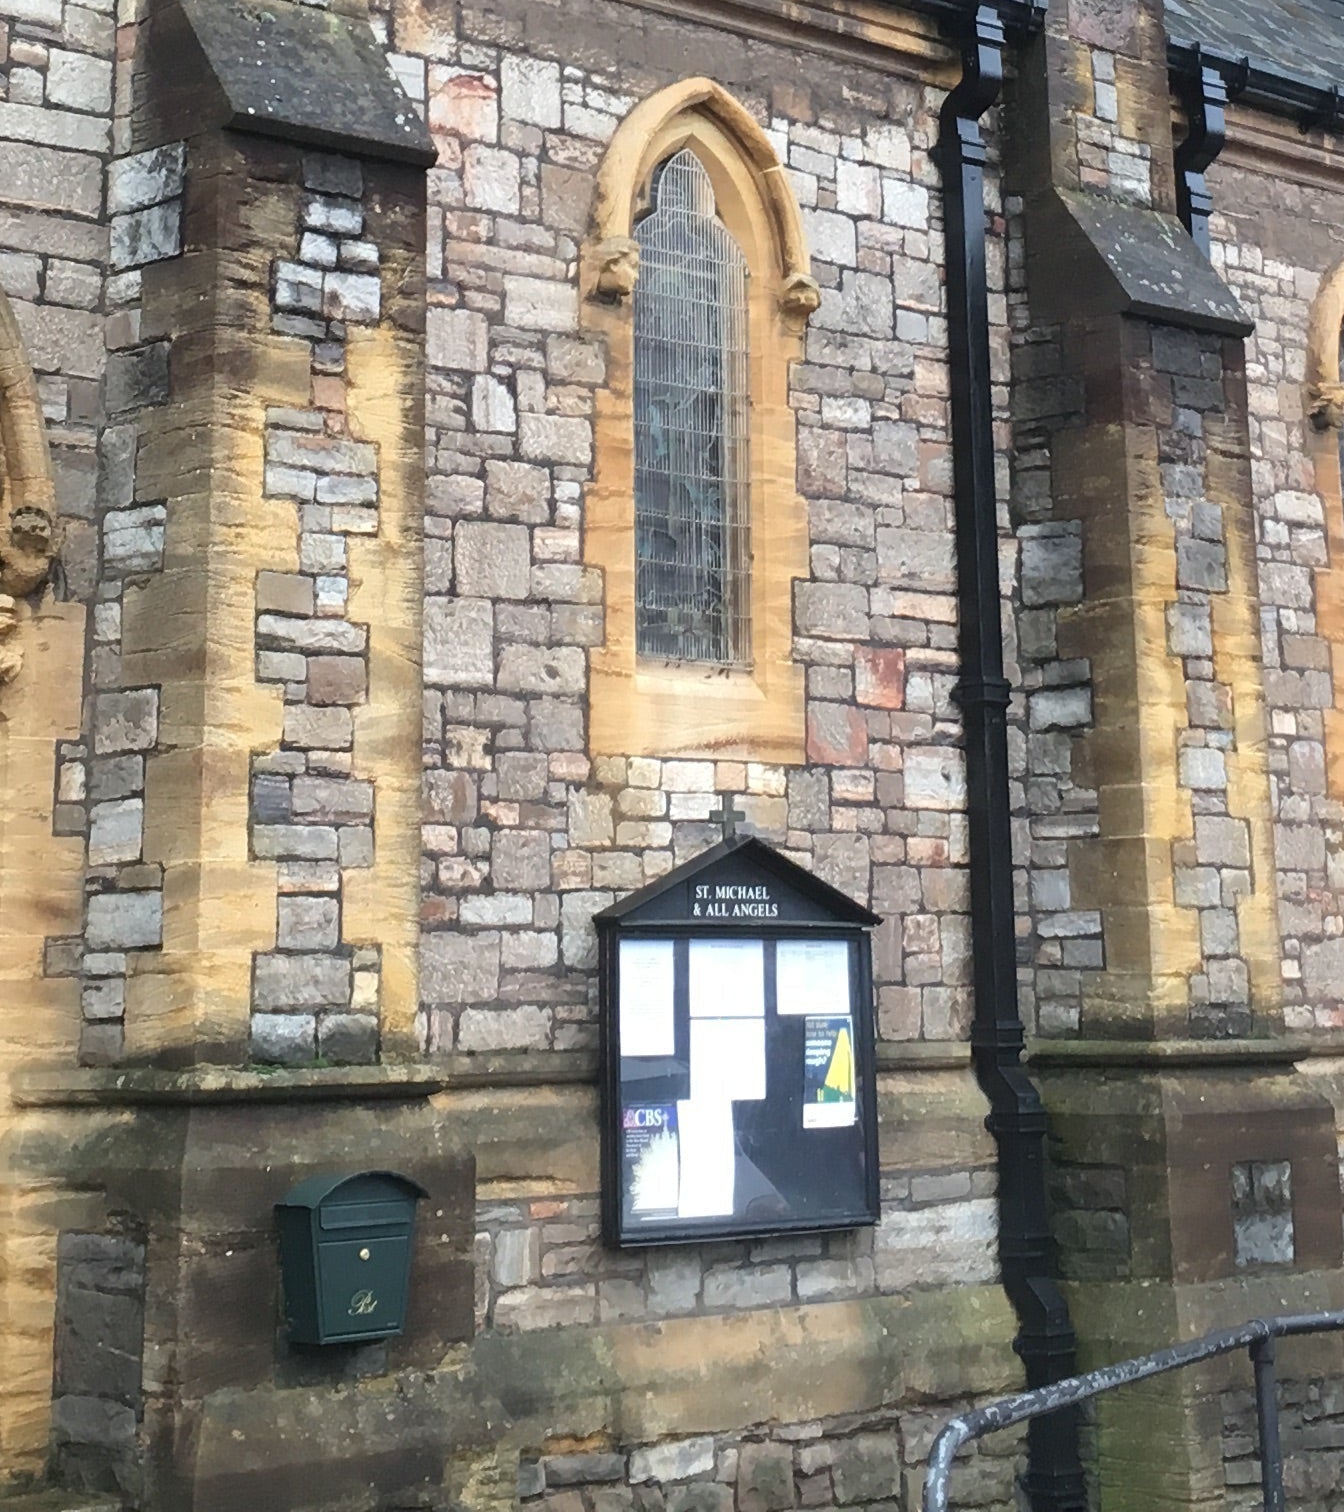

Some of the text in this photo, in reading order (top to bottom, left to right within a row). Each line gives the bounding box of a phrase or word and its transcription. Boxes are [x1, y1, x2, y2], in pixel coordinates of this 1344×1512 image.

[695, 885, 770, 900] ST. MICHAEL
[693, 902, 778, 917] & ALL ANGELS
